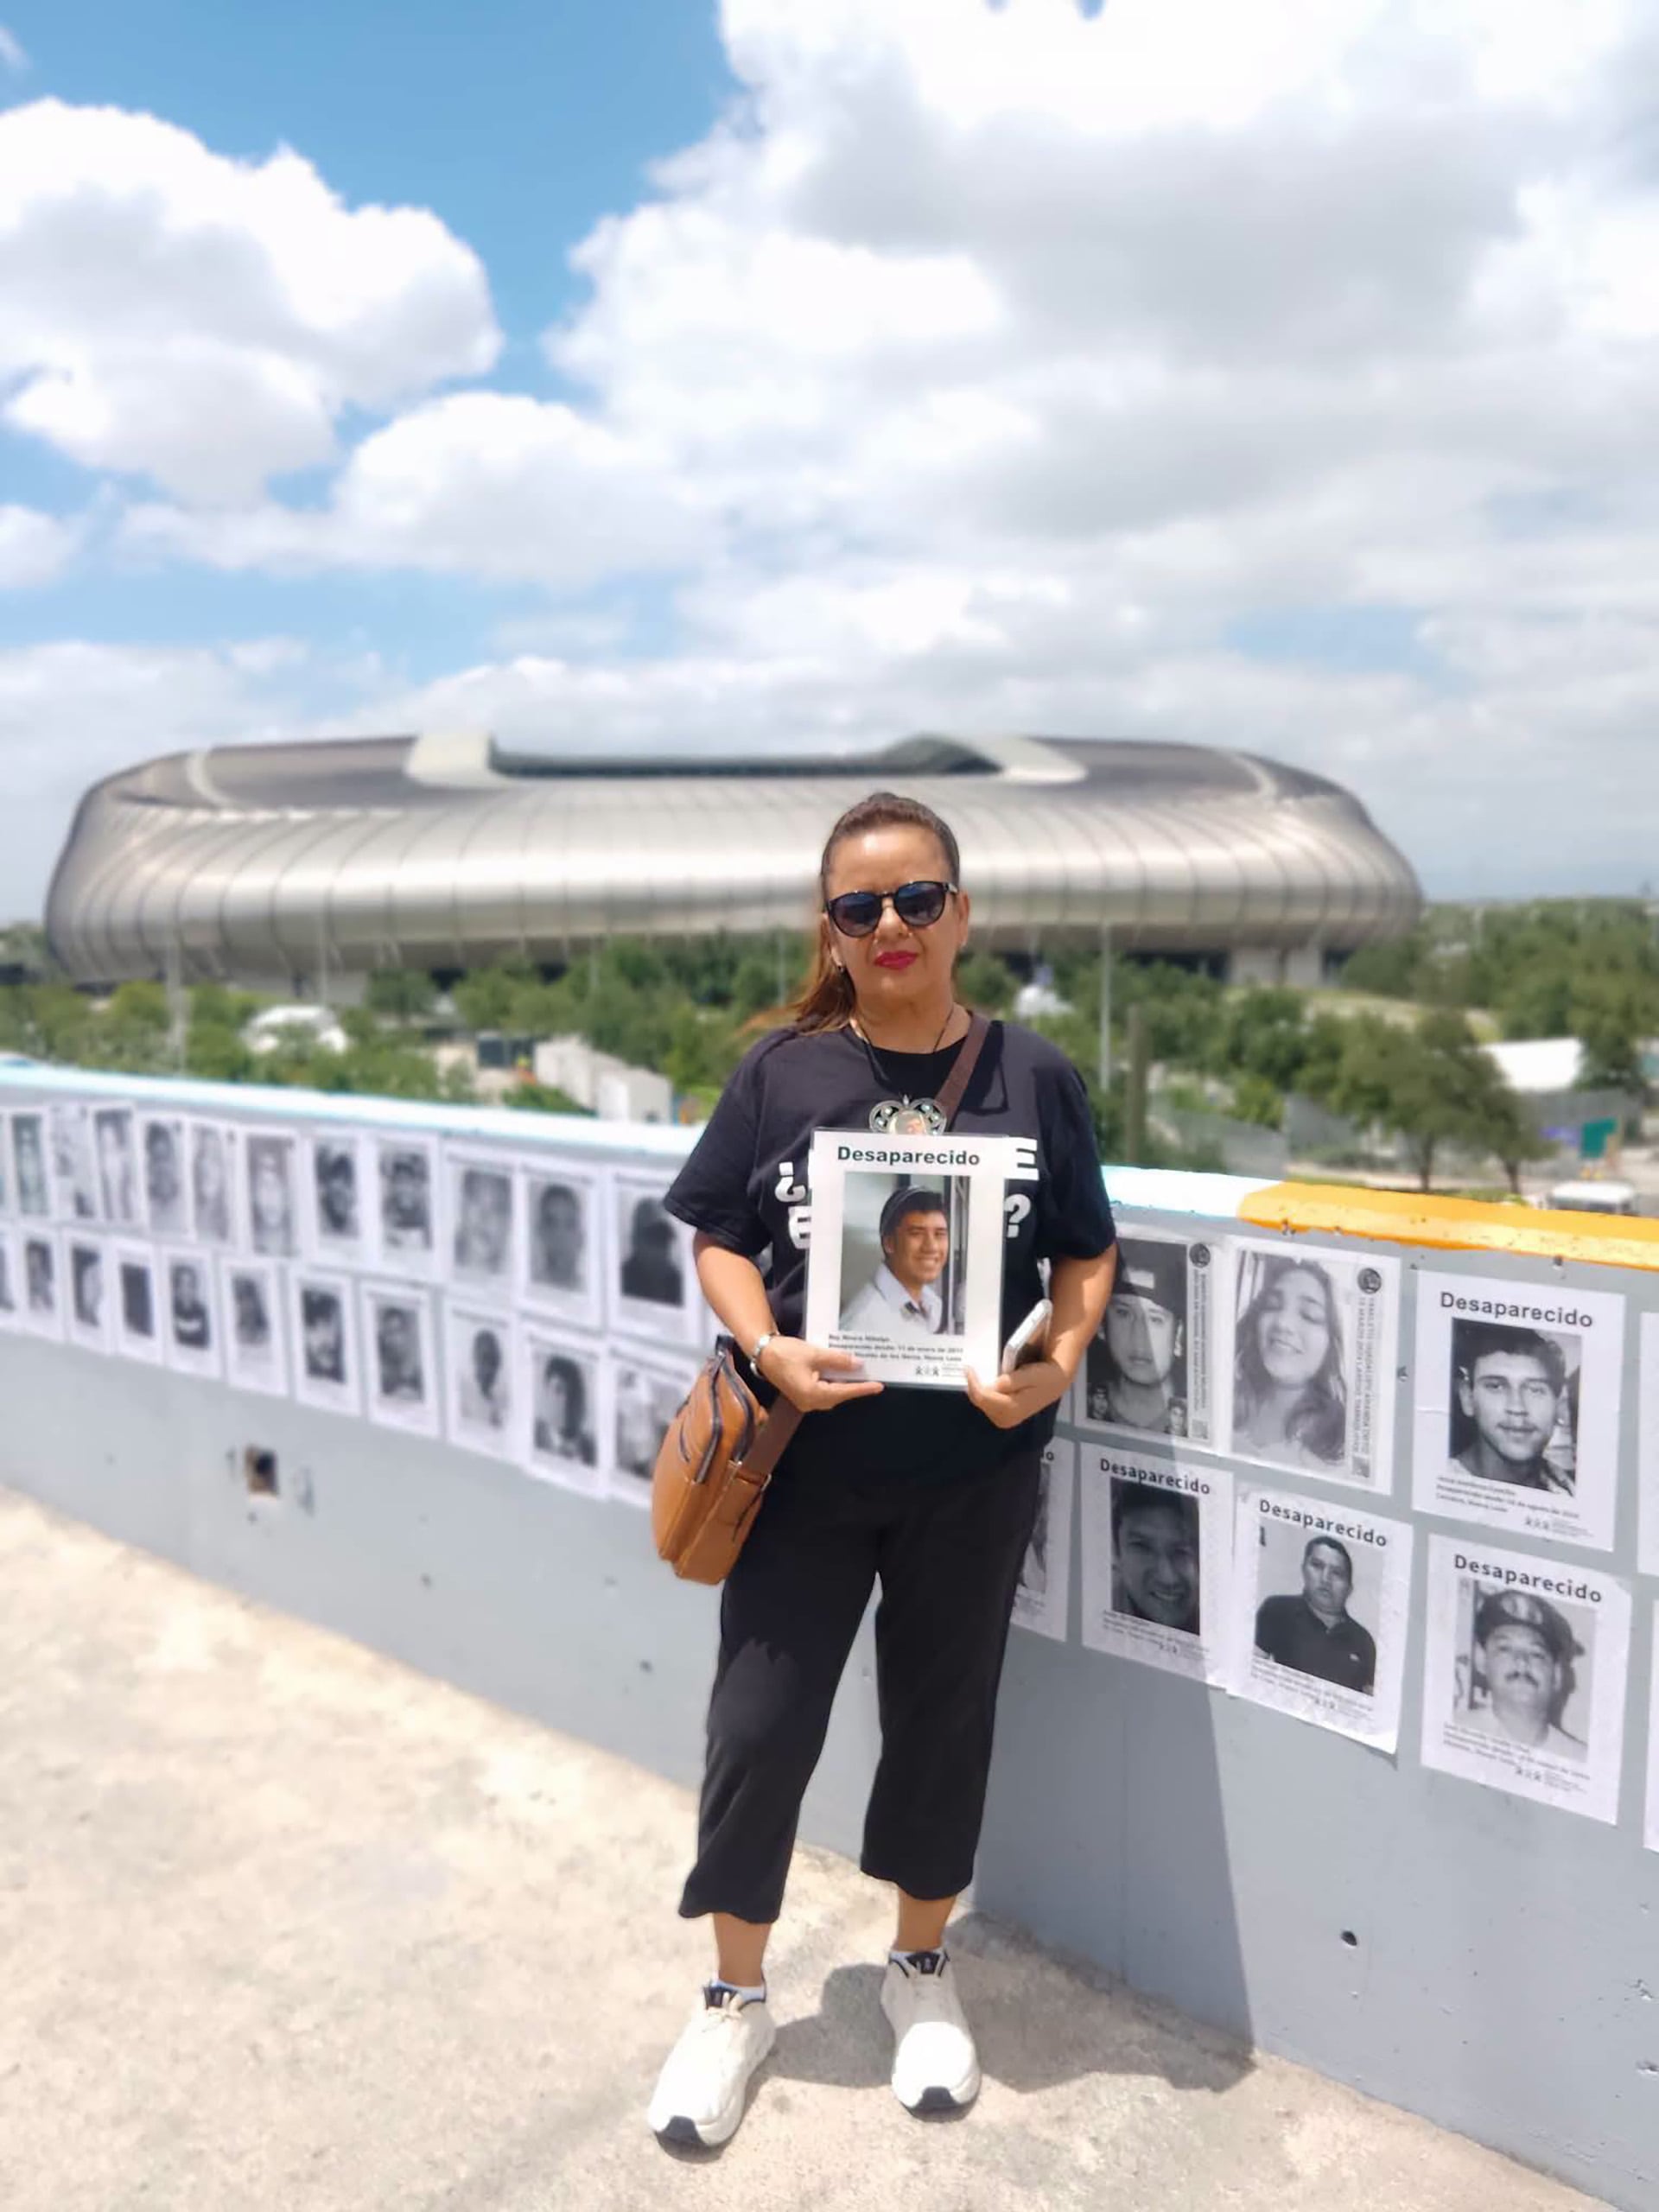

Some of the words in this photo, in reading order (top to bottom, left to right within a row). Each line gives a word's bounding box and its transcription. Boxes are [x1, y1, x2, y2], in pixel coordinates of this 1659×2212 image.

[837, 1147, 980, 1166] Desaparecido
[1440, 1291, 1592, 1327] Desaparecido
[1100, 1458, 1211, 1495] Desaparecido
[1260, 1498, 1387, 1547] Desaparecido
[1454, 1554, 1602, 1603] Desaparecido
